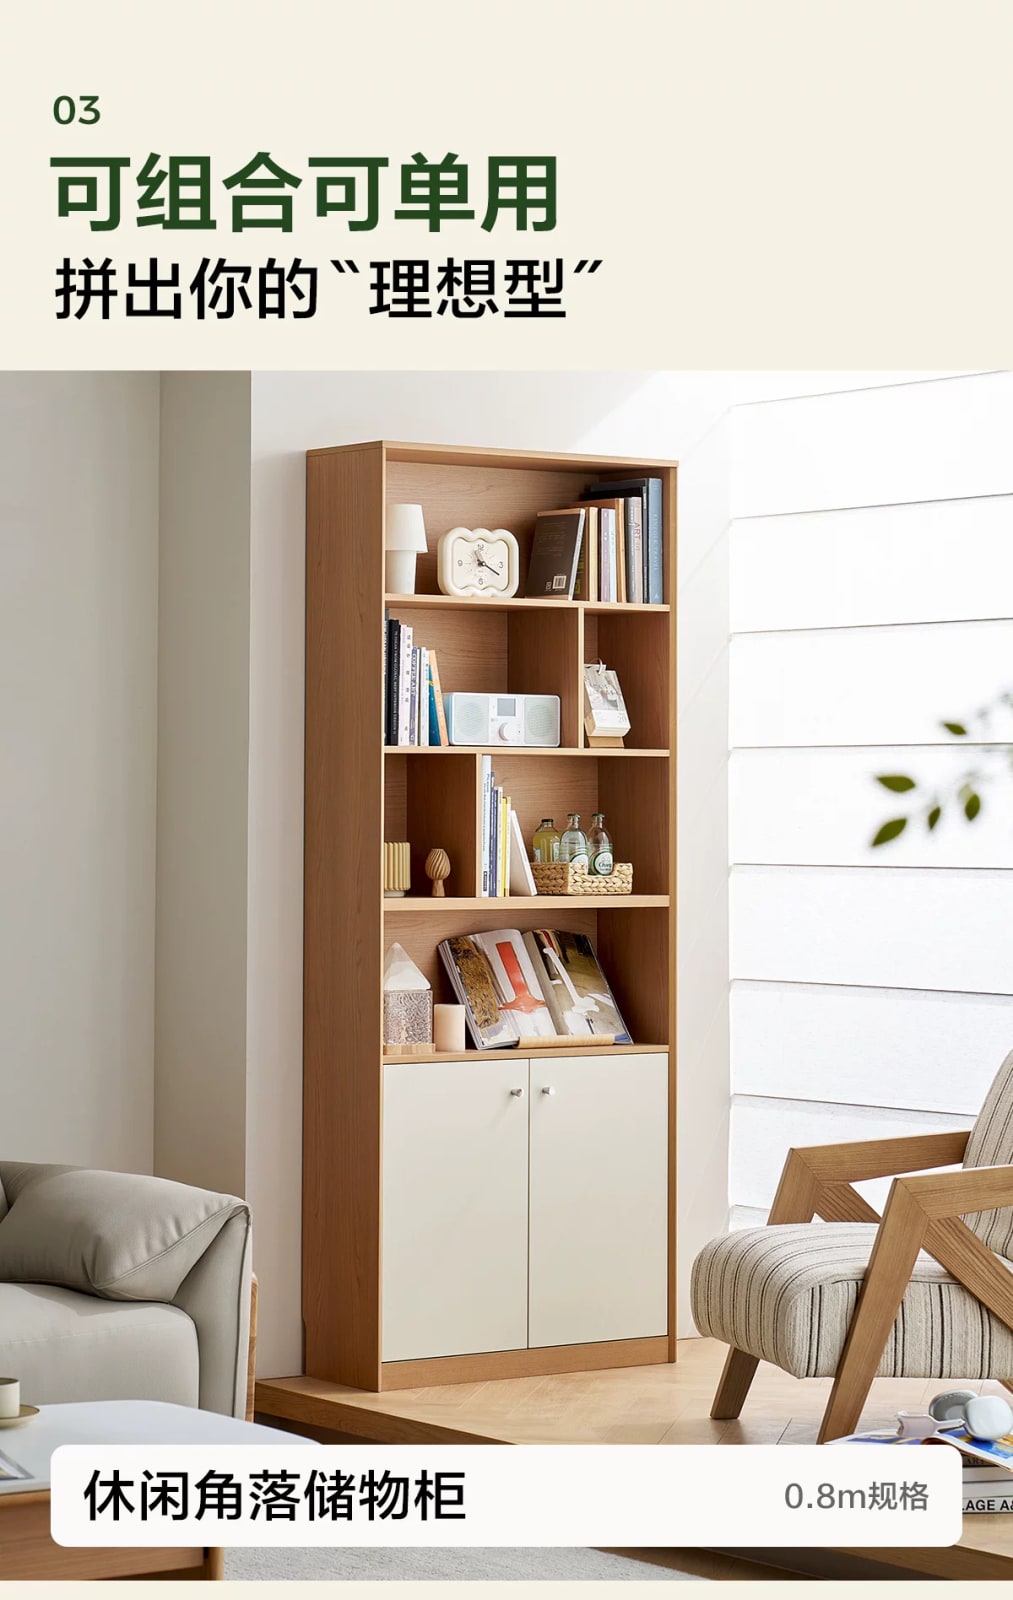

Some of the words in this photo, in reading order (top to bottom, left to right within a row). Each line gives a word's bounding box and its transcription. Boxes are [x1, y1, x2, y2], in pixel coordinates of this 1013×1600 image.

[457, 559, 463, 567] 9
[498, 561, 504, 569] 3
[478, 577, 484, 585] 6
[962, 1499, 996, 1511] AGE
